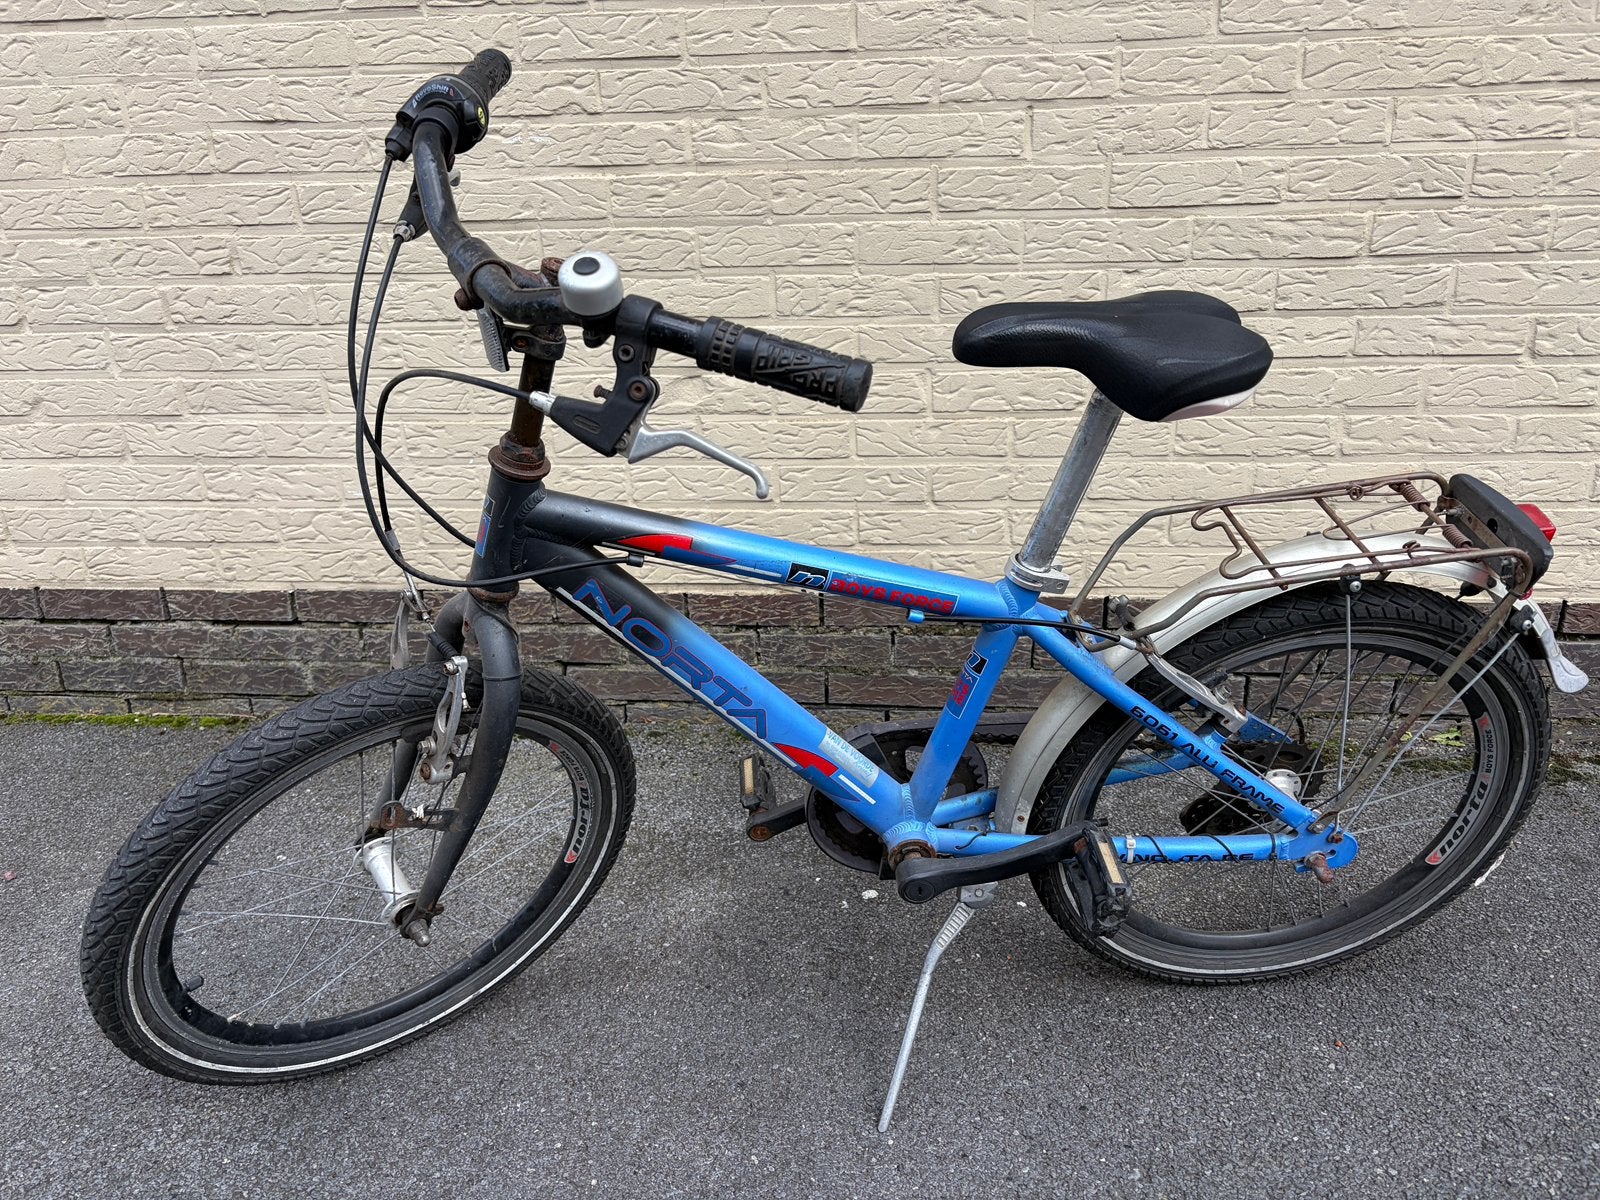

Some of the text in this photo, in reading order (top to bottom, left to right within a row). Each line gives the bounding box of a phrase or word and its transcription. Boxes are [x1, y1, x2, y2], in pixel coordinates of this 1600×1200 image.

[830, 578, 955, 614] BOYS FORCE
[573, 578, 768, 739] NORTA
[1129, 705, 1179, 741] 6061
[1221, 768, 1285, 814] FRAME
[1485, 754, 1495, 774] BOYS
[1487, 729, 1495, 753] FORCE
[572, 786, 590, 856] norta
[1438, 780, 1489, 857] norta
